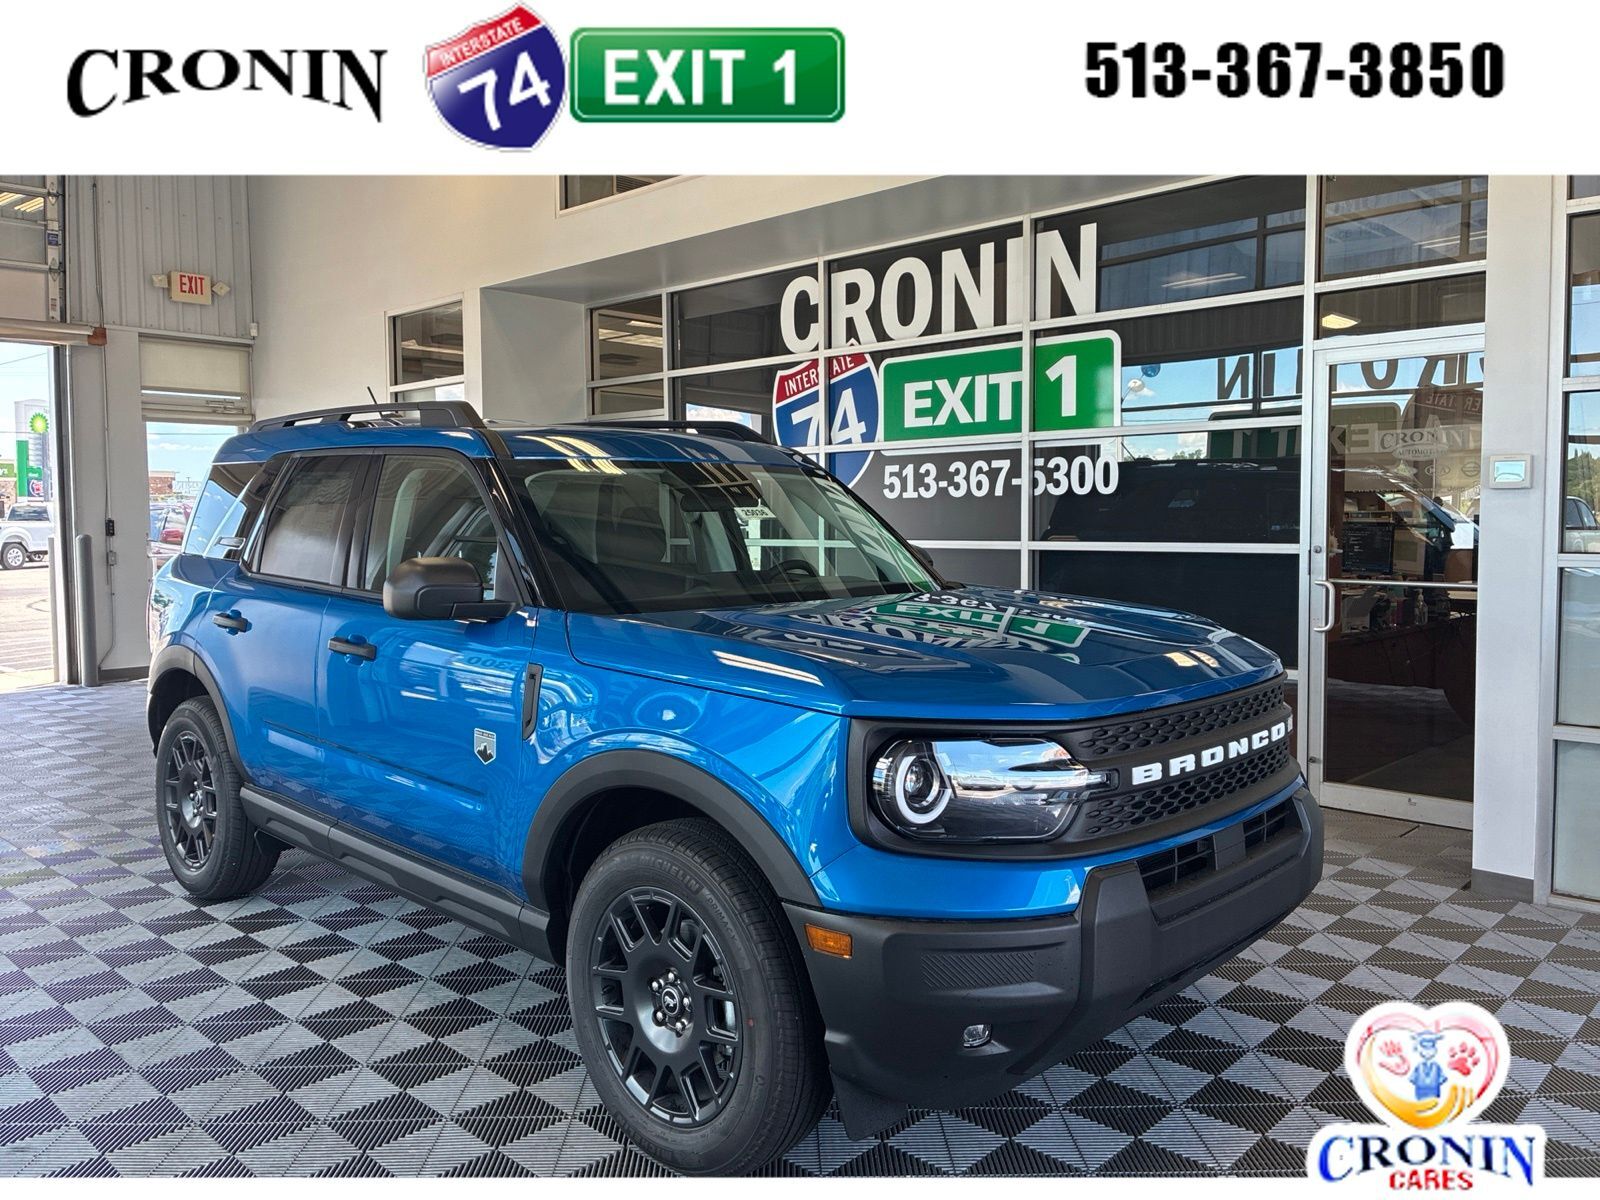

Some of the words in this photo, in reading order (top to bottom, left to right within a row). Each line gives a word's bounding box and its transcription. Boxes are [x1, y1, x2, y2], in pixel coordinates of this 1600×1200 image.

[179, 274, 205, 296] EXIT
[780, 222, 1098, 354] CRONIN
[791, 387, 867, 447] 74
[904, 371, 1023, 428] EXIT
[1045, 355, 1077, 417] 1
[882, 454, 1119, 499] 513-367-5300
[1131, 721, 1287, 786] BRONCO
[640, 855, 703, 892] MICHELIN
